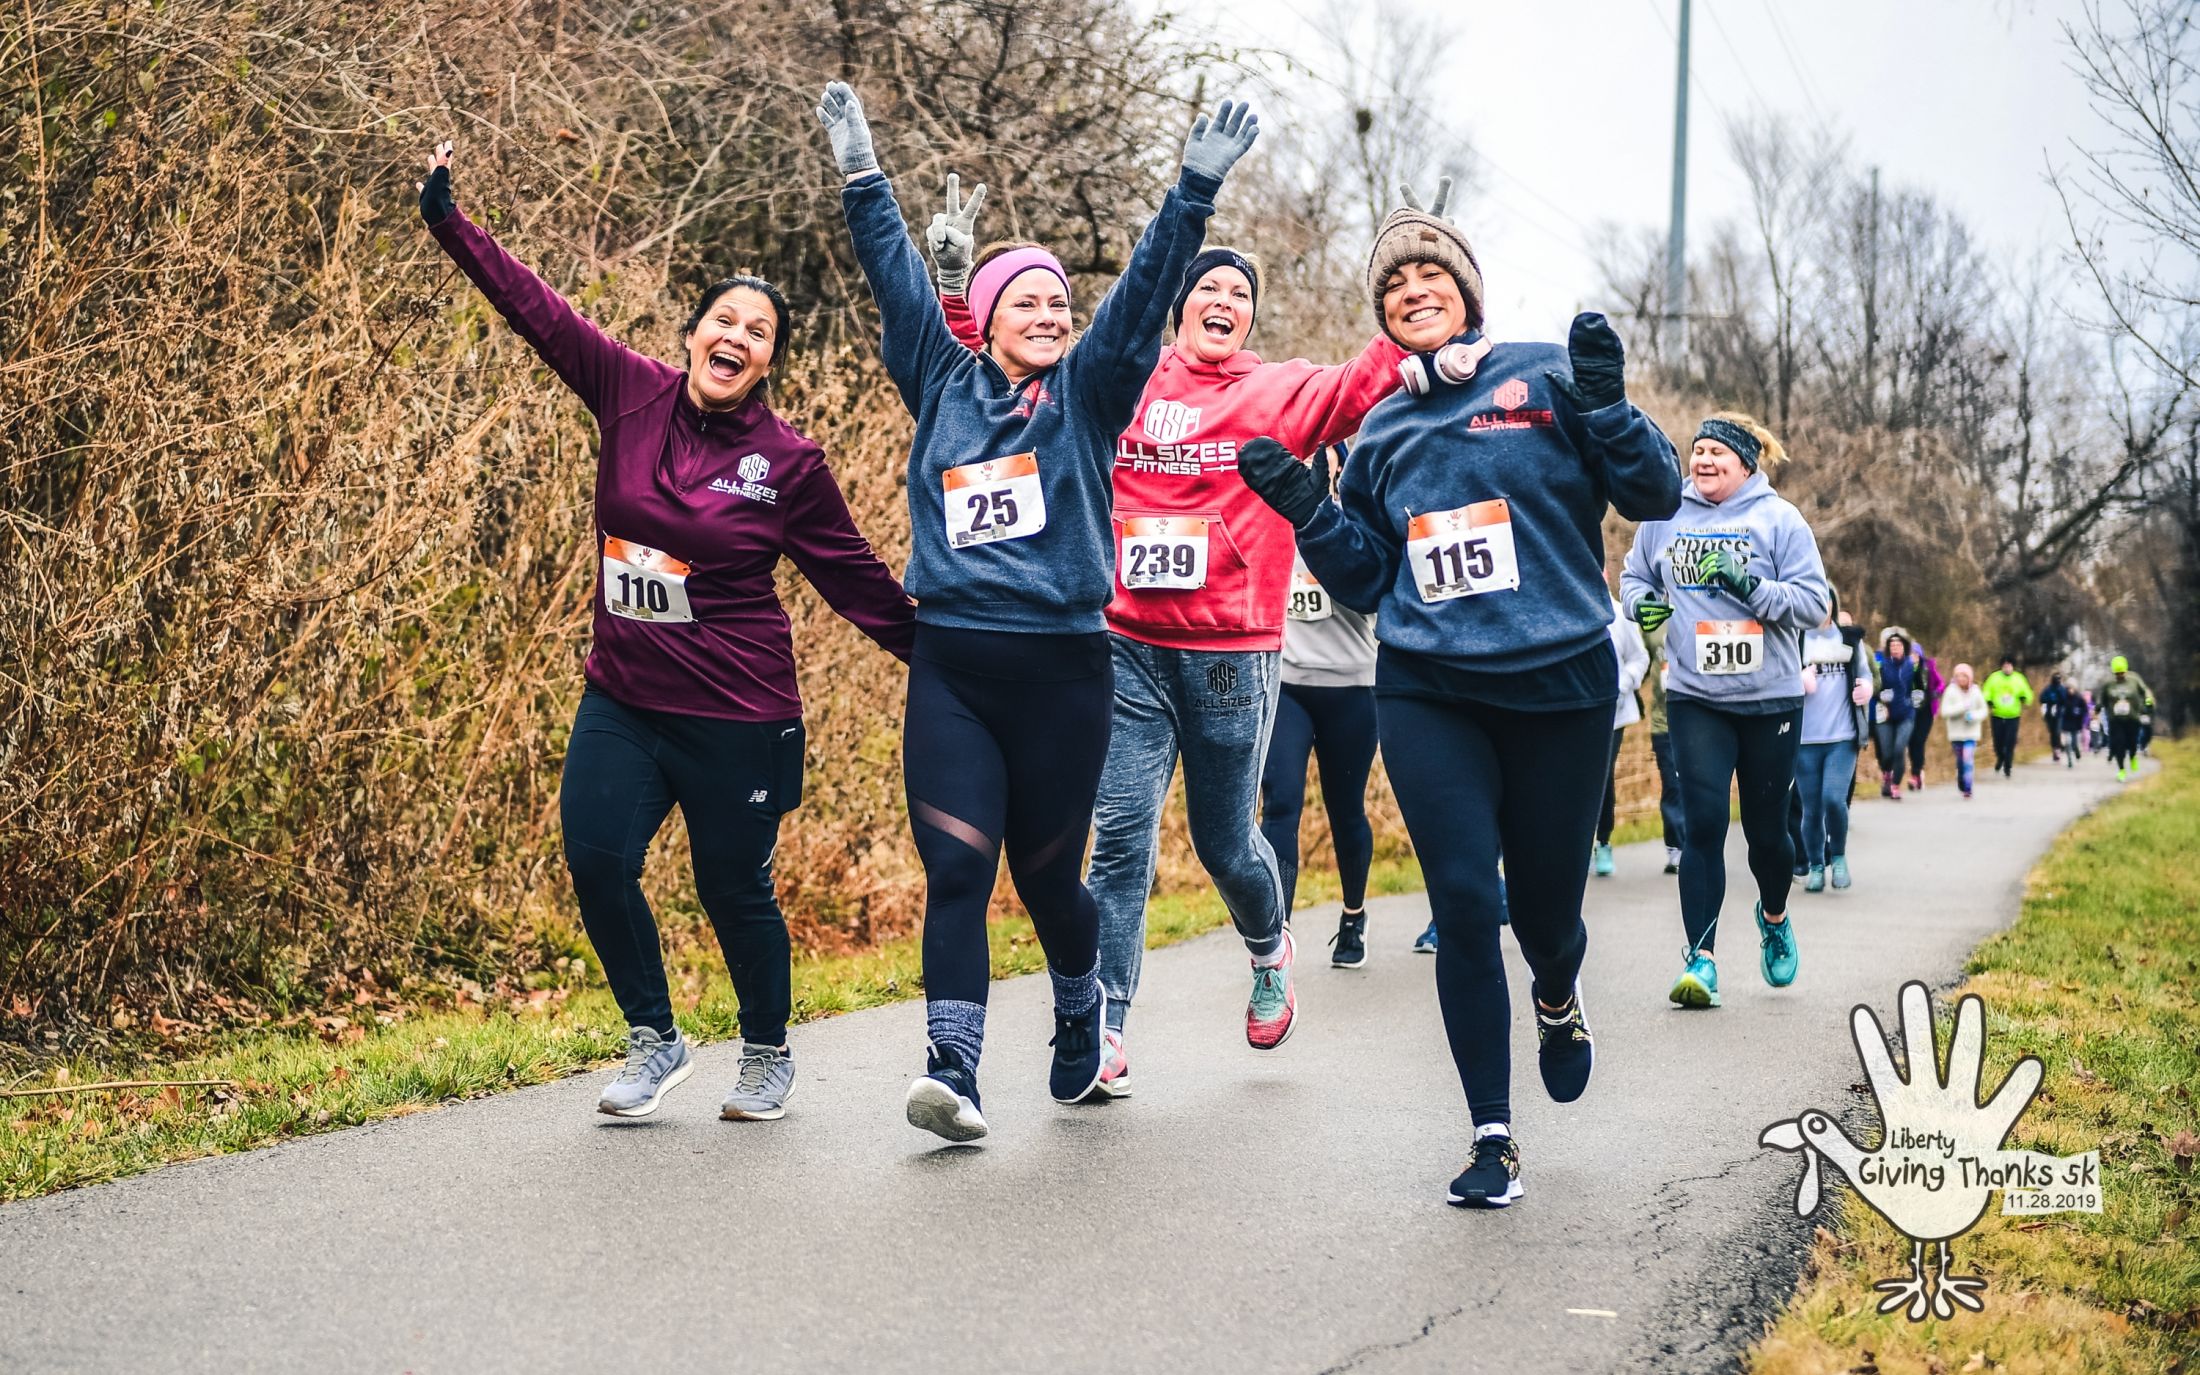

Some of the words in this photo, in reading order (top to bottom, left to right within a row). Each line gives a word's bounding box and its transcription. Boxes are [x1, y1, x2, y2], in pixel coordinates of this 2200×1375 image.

[1146, 400, 1200, 442] ASF
[1470, 413, 1504, 429] ALL
[1504, 409, 1553, 424] SIZES
[1490, 421, 1532, 431] FITNESS
[1156, 440, 1237, 463] SIZES
[740, 455, 768, 481] ASF
[1133, 459, 1201, 476] FITNESS
[711, 477, 741, 491] ALL
[741, 481, 779, 500] SIZES
[726, 488, 762, 502] FITNESS
[967, 488, 1019, 532] 25
[1129, 544, 1195, 578] 239
[1425, 537, 1494, 586] 115
[617, 572, 670, 613] 110
[1706, 642, 1752, 666] 310
[1209, 662, 1237, 693] ASF
[1194, 699, 1219, 709] ALL
[1219, 696, 1252, 708] SIZES
